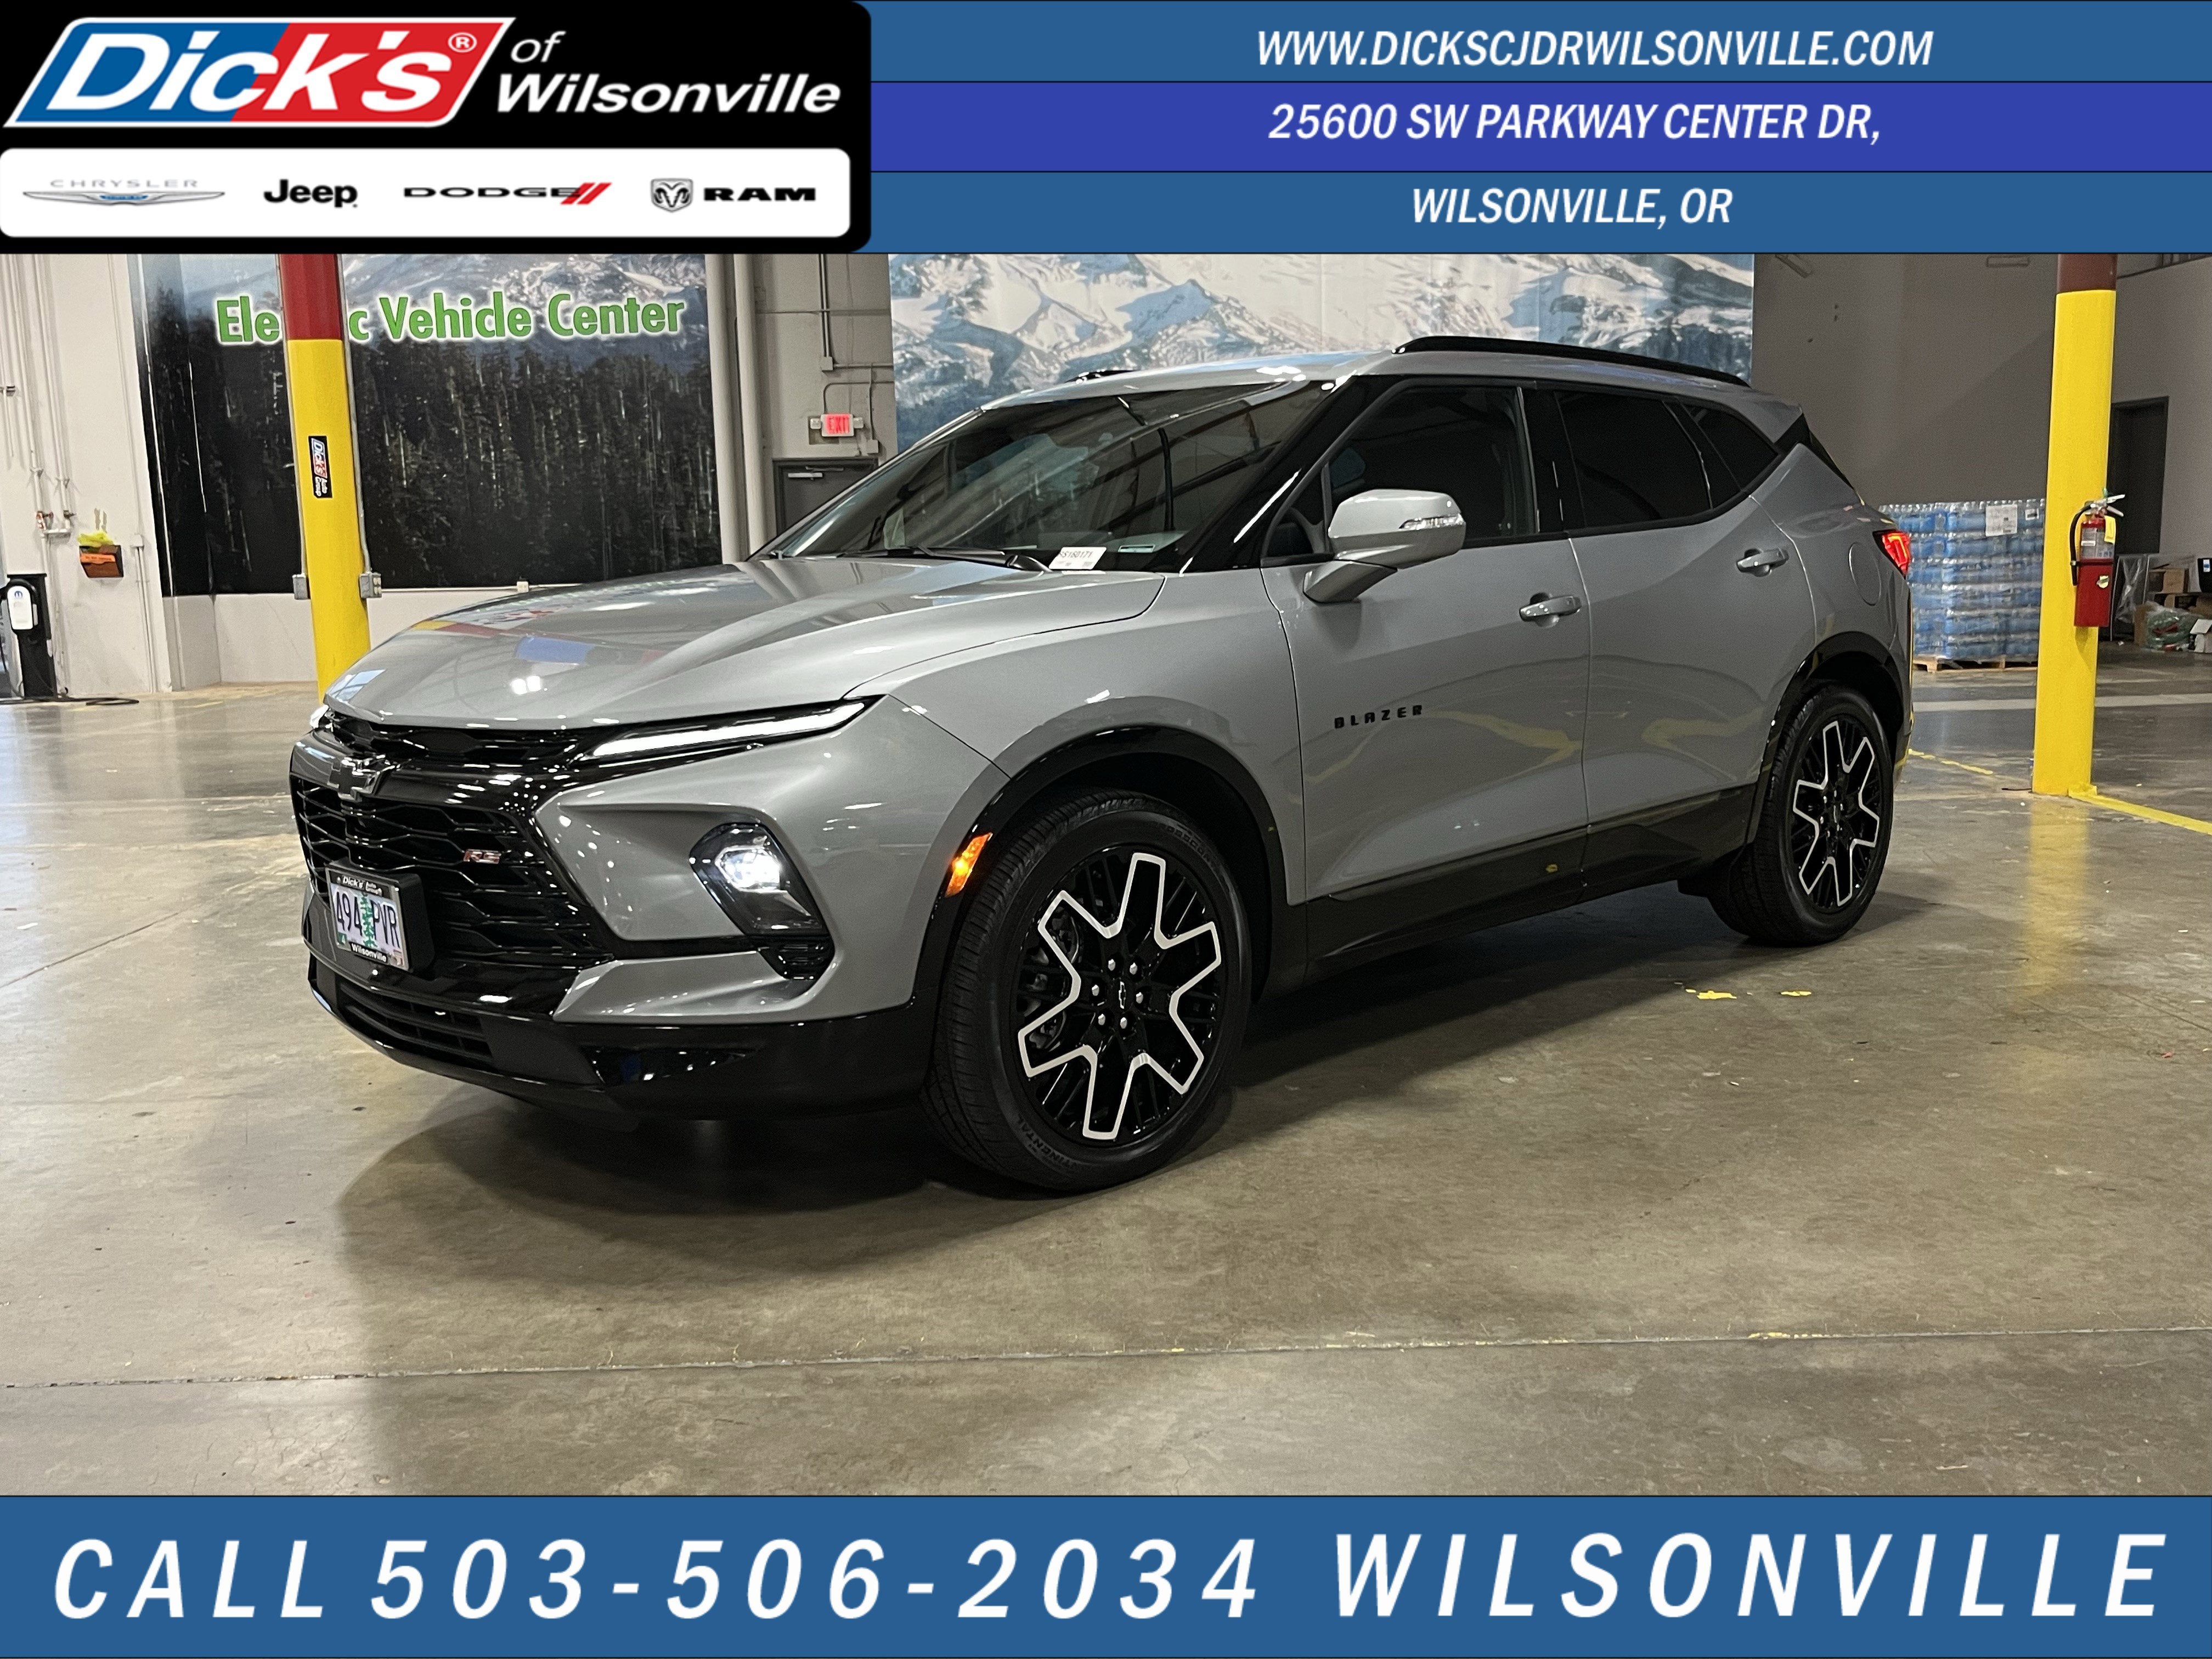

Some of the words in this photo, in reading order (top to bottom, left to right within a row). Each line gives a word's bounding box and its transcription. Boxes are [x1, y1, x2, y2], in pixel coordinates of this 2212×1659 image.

[217, 295, 369, 342] Elec
[379, 291, 532, 339] Vehicle
[548, 293, 685, 336] Center
[828, 415, 850, 433] EXIT
[1334, 704, 1423, 729] BLAZER
[463, 848, 502, 865] RS
[336, 891, 363, 937] 494
[370, 899, 400, 949] PVR
[352, 943, 387, 962] Wilsonville
